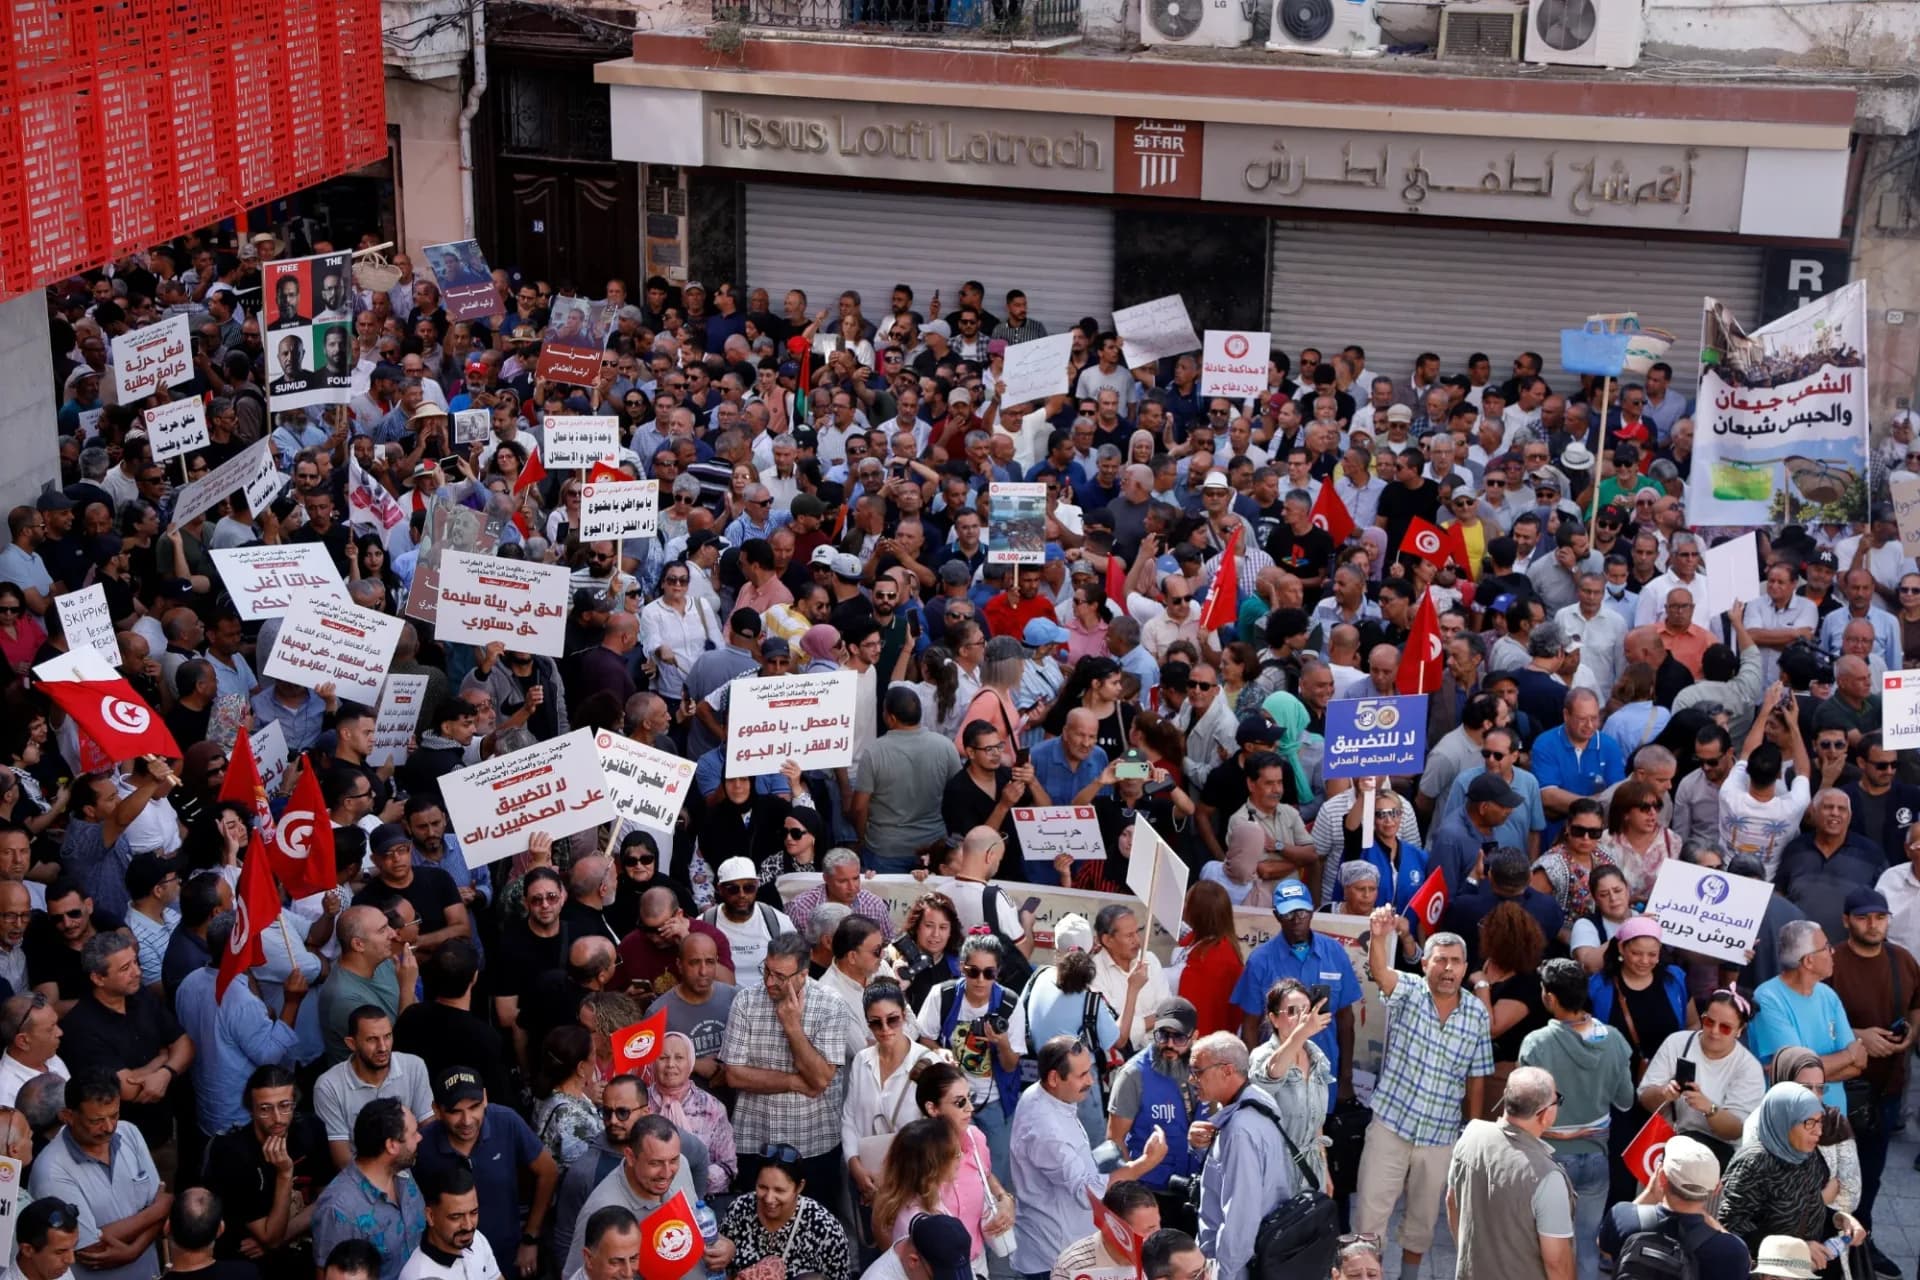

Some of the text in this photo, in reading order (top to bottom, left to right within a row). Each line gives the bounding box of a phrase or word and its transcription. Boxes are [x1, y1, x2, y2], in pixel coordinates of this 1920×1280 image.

[715, 109, 1102, 171] Tissus Lotfi Latrach
[533, 220, 545, 232] 18
[277, 256, 343, 273] FREE THE
[1788, 259, 1824, 291] R
[275, 380, 307, 393] SUMUD
[1715, 373, 1852, 414] الشعب جيعان
[1713, 404, 1852, 439] والحبس شبعان
[442, 588, 481, 606] سليمة
[484, 593, 507, 612] بيئة
[510, 601, 531, 617] في
[534, 604, 563, 617] الحق
[462, 616, 538, 636] حق دستوري
[800, 716, 837, 731] معطل
[841, 714, 850, 728] يا
[1354, 700, 1400, 731] 50
[738, 720, 776, 737] مقموع
[780, 719, 789, 734] يا
[776, 741, 792, 756] زاد
[803, 738, 831, 754] الفقر
[833, 737, 849, 751] زاد
[1331, 730, 1416, 754] لا للتضييق
[736, 744, 774, 761] الجوع
[1329, 752, 1415, 770] على المجتمع المدني
[556, 776, 568, 792] لا
[570, 788, 604, 810] على
[1655, 899, 1754, 930] المجتمع المدني
[1697, 928, 1746, 949] موش
[444, 1073, 459, 1089] TOP
